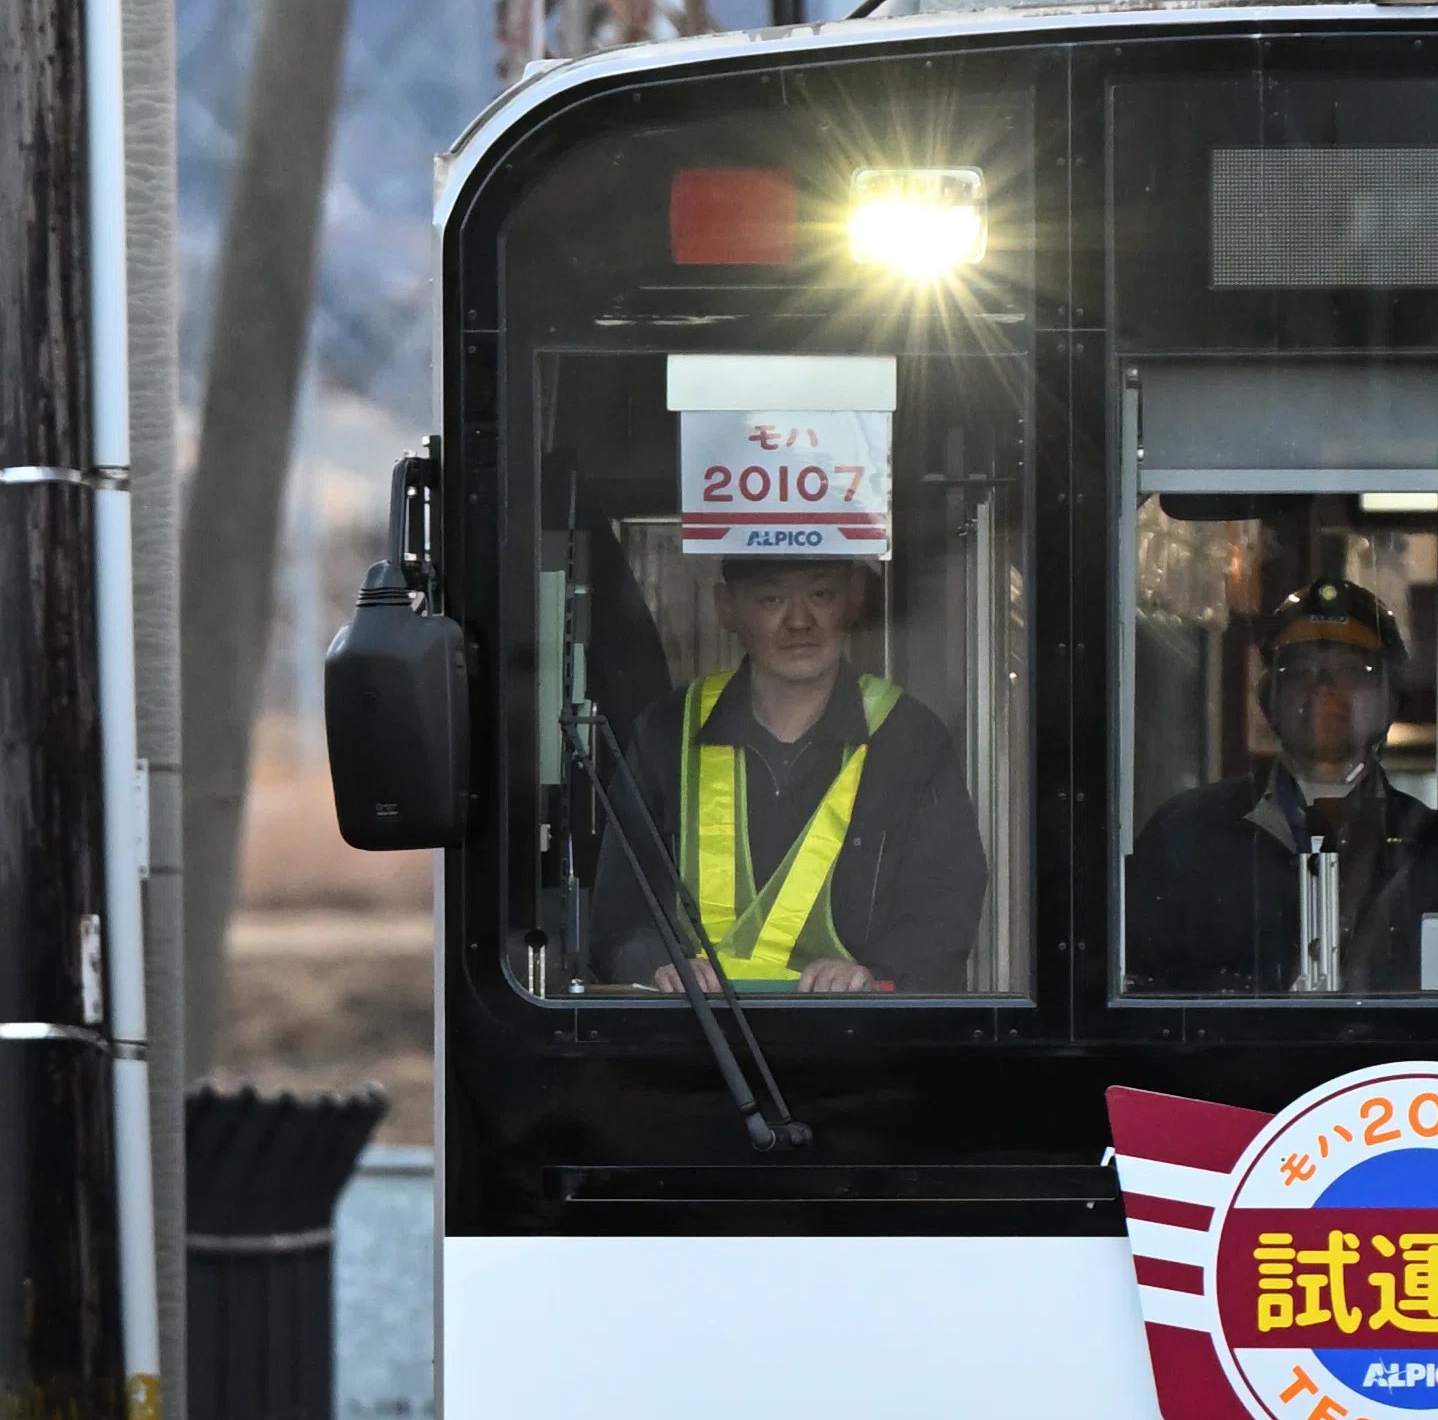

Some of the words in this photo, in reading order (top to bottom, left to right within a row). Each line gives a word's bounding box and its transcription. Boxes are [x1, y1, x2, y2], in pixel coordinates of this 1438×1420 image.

[747, 424, 819, 451] モハ
[702, 465, 866, 502] 20107
[745, 530, 823, 547] ALPICO
